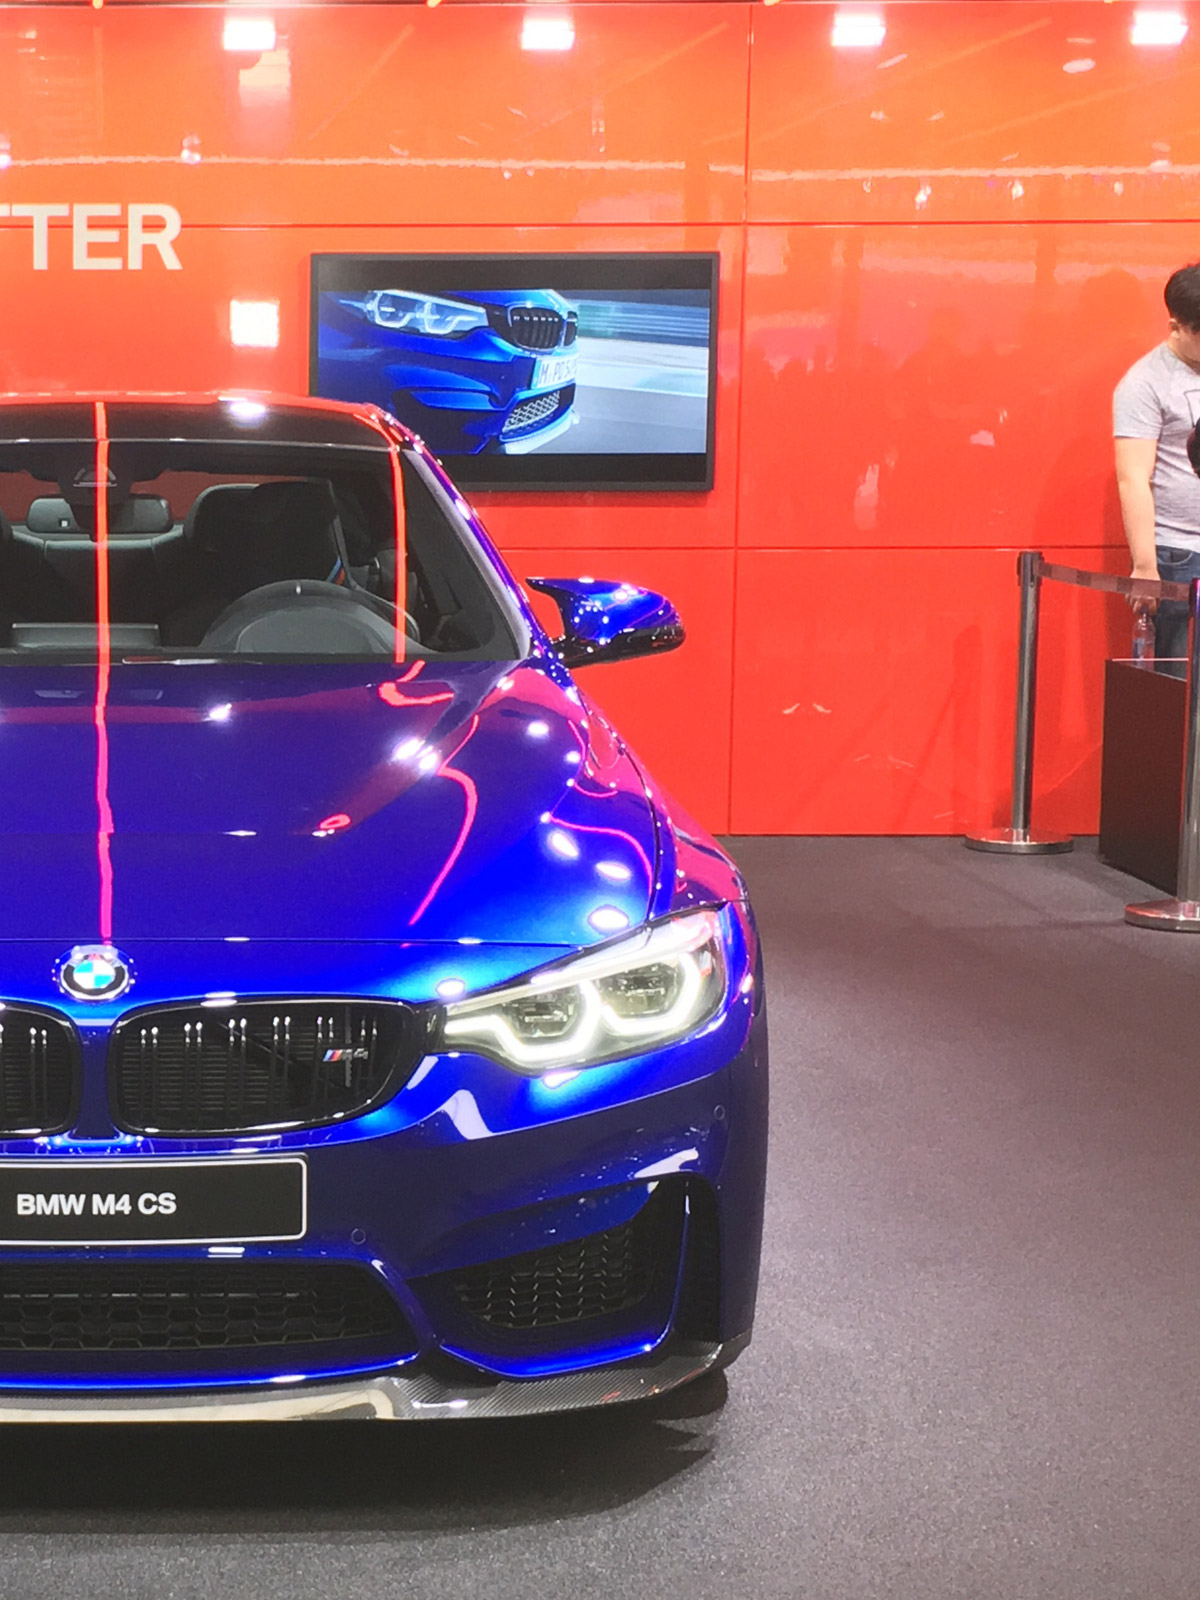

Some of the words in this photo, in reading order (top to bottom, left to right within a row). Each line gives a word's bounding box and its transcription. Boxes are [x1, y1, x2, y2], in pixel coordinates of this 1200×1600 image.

[17, 1194, 86, 1216] BMW
[92, 1193, 132, 1215] M4
[138, 1192, 177, 1215] CS
